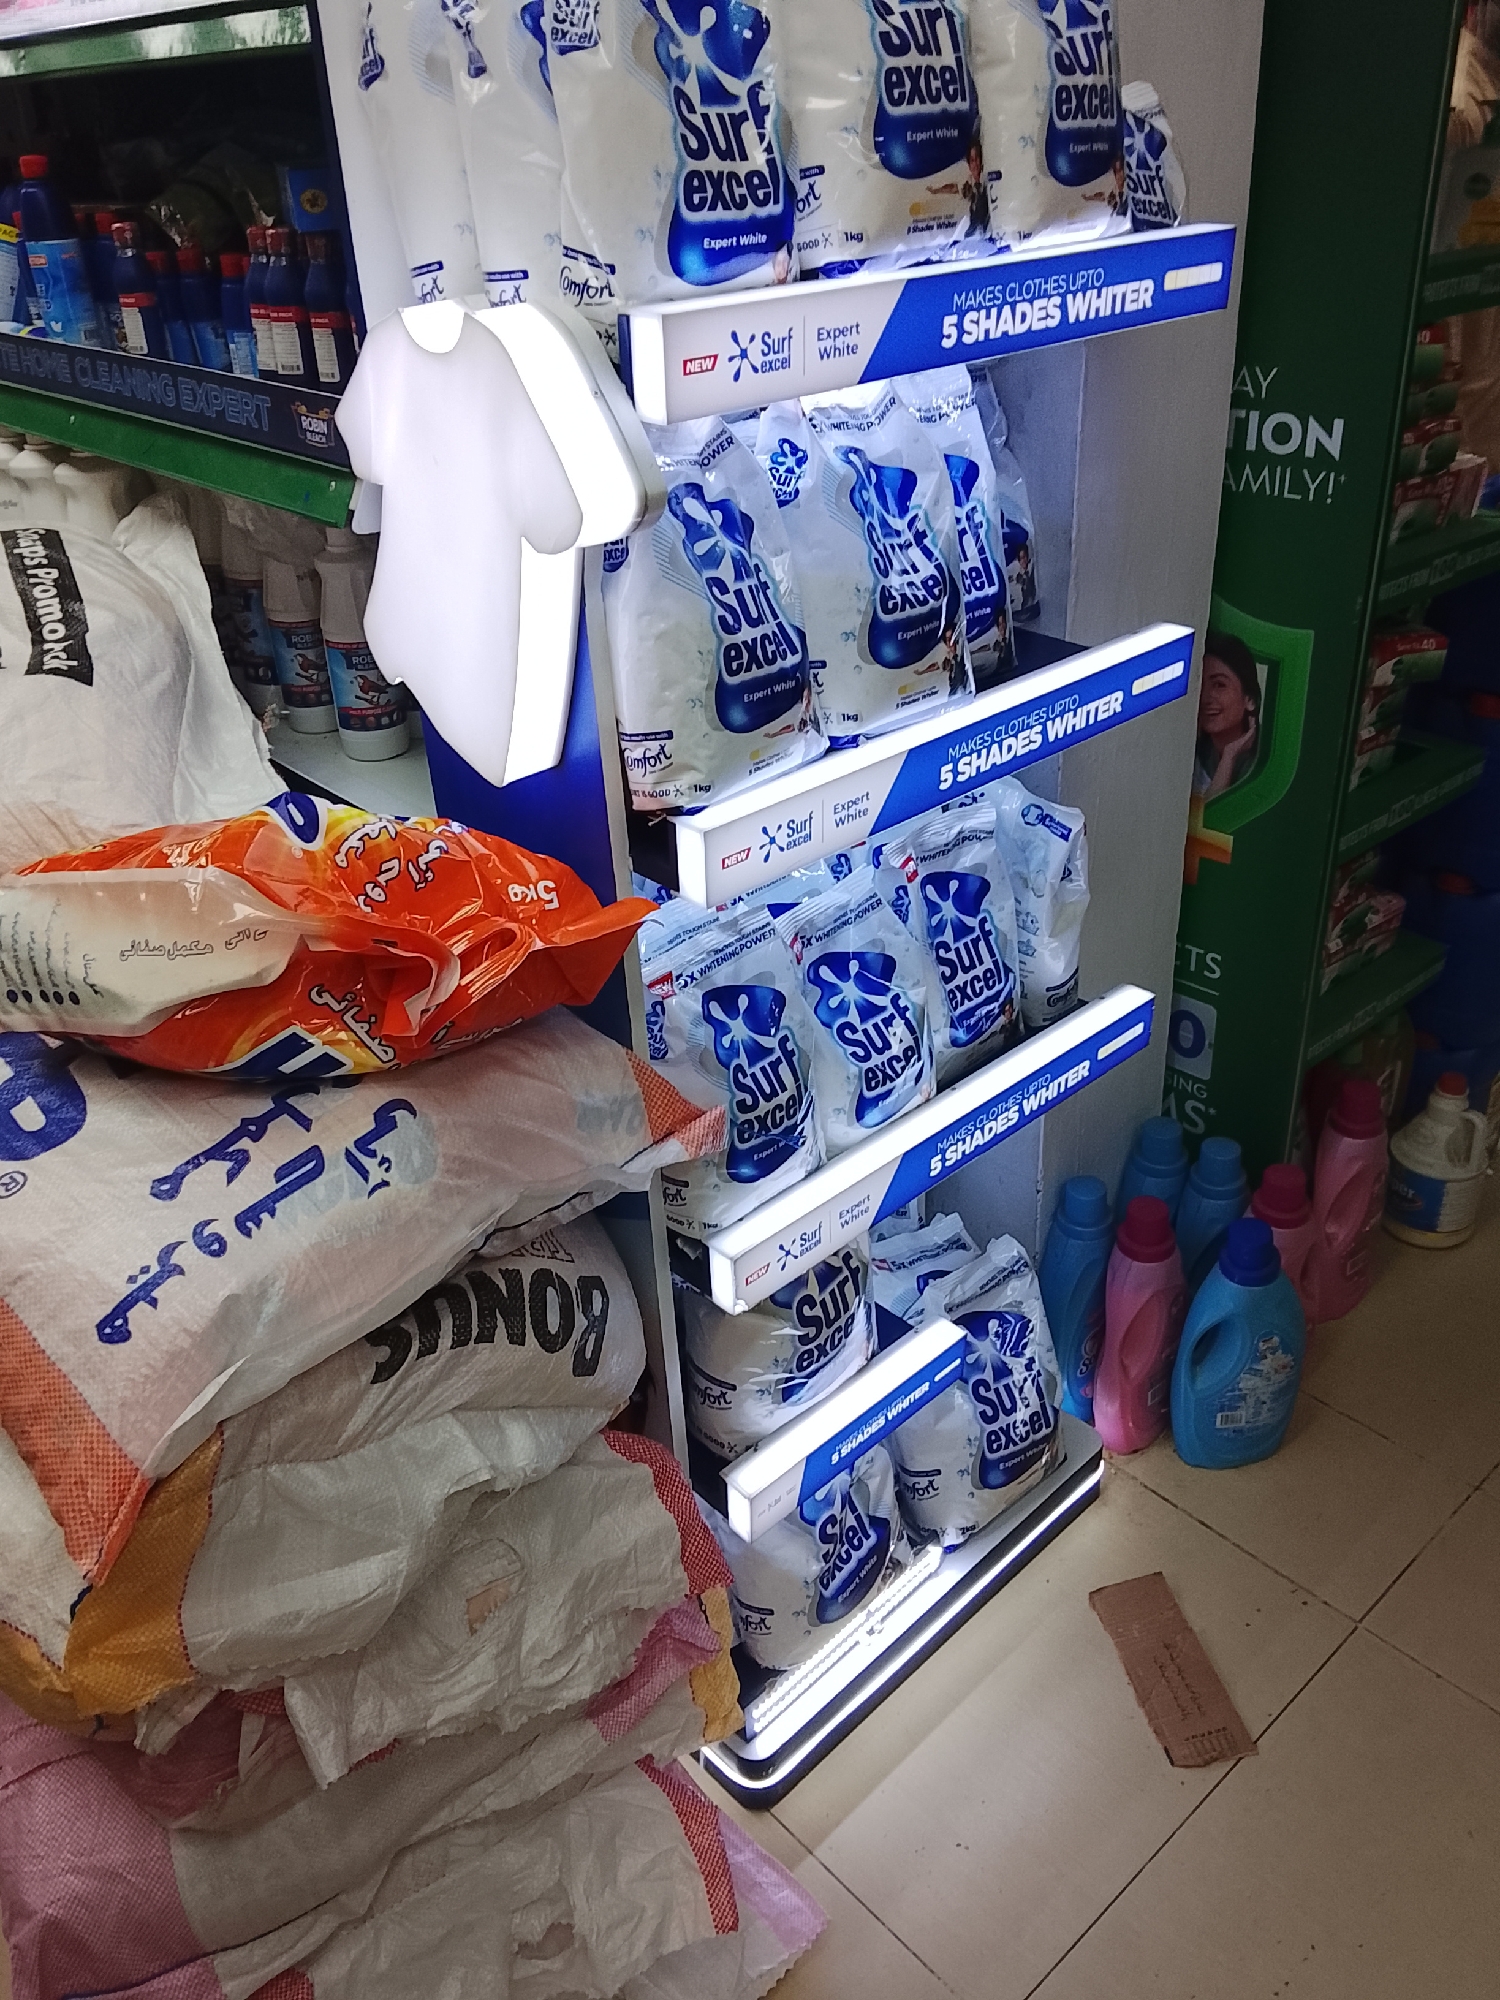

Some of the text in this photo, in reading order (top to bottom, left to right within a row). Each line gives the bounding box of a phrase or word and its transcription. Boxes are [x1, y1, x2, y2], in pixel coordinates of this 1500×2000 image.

[875, 0, 961, 58] Surf
[1046, 9, 1113, 76] Surf
[884, 56, 967, 108] excel
[1055, 78, 1116, 122] excel
[674, 80, 774, 162] Surf
[906, 127, 959, 142] Expert White
[683, 162, 780, 213] excel
[1126, 164, 1166, 198] Surf
[1131, 199, 1172, 220] excel
[703, 232, 768, 250] Expert White
[843, 231, 864, 243] 1kg
[952, 267, 1105, 312] MAKES CLOTHES UPTO
[816, 321, 861, 342] Expert
[941, 278, 1155, 349] 5 SHADES WHITER
[760, 353, 791, 374] excel
[761, 326, 793, 357] Surf
[817, 343, 859, 361] White
[684, 356, 715, 374] NEW
[20, 346, 72, 384] HOME
[74, 355, 177, 408] CLEANING
[177, 376, 272, 431] EXPERT
[300, 415, 328, 435] ROBIN
[26, 567, 67, 641] Promo
[705, 562, 780, 636] Surf
[879, 561, 948, 616] excel
[723, 620, 799, 678] excel
[897, 626, 922, 641] Expert
[743, 679, 797, 703] Expert White
[841, 713, 859, 723] 1kg
[938, 690, 1124, 791] 5 SHADES WHITER
[948, 694, 1080, 761] MAKES CLOTHES UPTO
[693, 783, 712, 793] 1kg
[833, 790, 871, 815] Expert
[786, 810, 814, 839] Surf
[834, 806, 869, 829] White
[724, 848, 750, 868] NEW
[786, 832, 812, 852] excel
[814, 915, 853, 943] WHITENING
[852, 897, 883, 924] POWER
[934, 914, 997, 987] Surf
[1174, 943, 1222, 980] TS
[946, 957, 1003, 1012] excel
[309, 983, 395, 1067] صفائی
[835, 991, 917, 1065] Surf
[732, 1033, 801, 1115] Surf
[736, 1083, 805, 1145] excel
[929, 1060, 1091, 1178] 5 SHADES WHITER
[937, 1073, 1052, 1154] MAKES CLOTHES UPTO
[345, 1098, 418, 1199] آئی
[753, 1144, 778, 1162] Expert
[838, 1194, 871, 1220] Expert
[839, 1205, 870, 1230] White
[799, 1220, 823, 1247] Surf
[799, 1238, 822, 1258] excel
[746, 1263, 770, 1285] NEW
[795, 1250, 862, 1347] Surf
[796, 1310, 856, 1374] exce
[970, 1354, 1047, 1426] Surf
[830, 1381, 931, 1465] 5 SHADES WHITER
[985, 1401, 1052, 1455] excel
[999, 1452, 1024, 1471] Expert
[837, 1554, 878, 1603] Expert White
